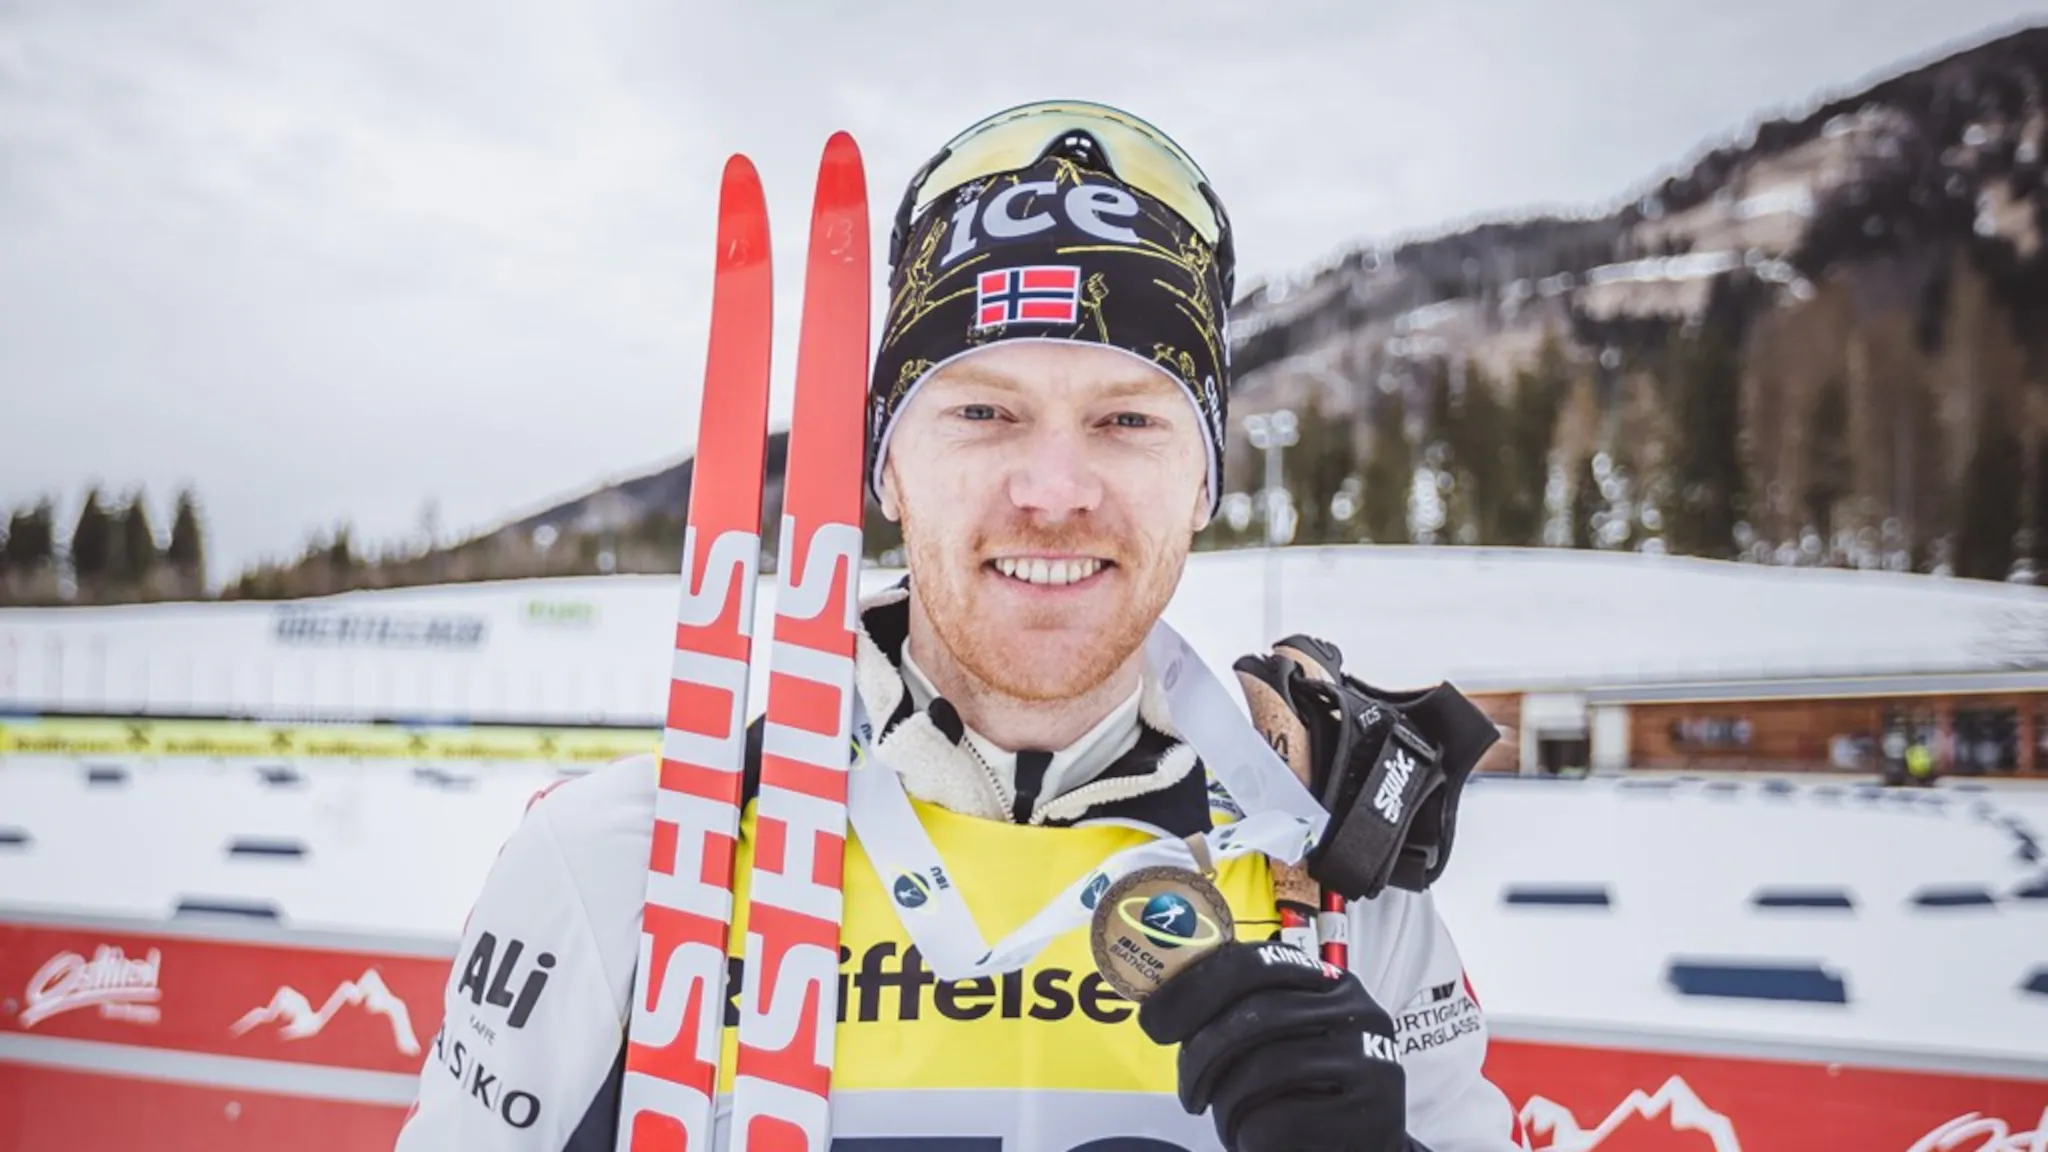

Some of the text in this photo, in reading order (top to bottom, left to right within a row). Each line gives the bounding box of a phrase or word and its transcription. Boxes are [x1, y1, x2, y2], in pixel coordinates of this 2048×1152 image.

[940, 181, 1140, 267] ice
[1358, 705, 1382, 730] TCS
[930, 865, 949, 891] IBU
[1110, 943, 1162, 985] BIATHLON
[1118, 936, 1165, 970] IBU CUP
